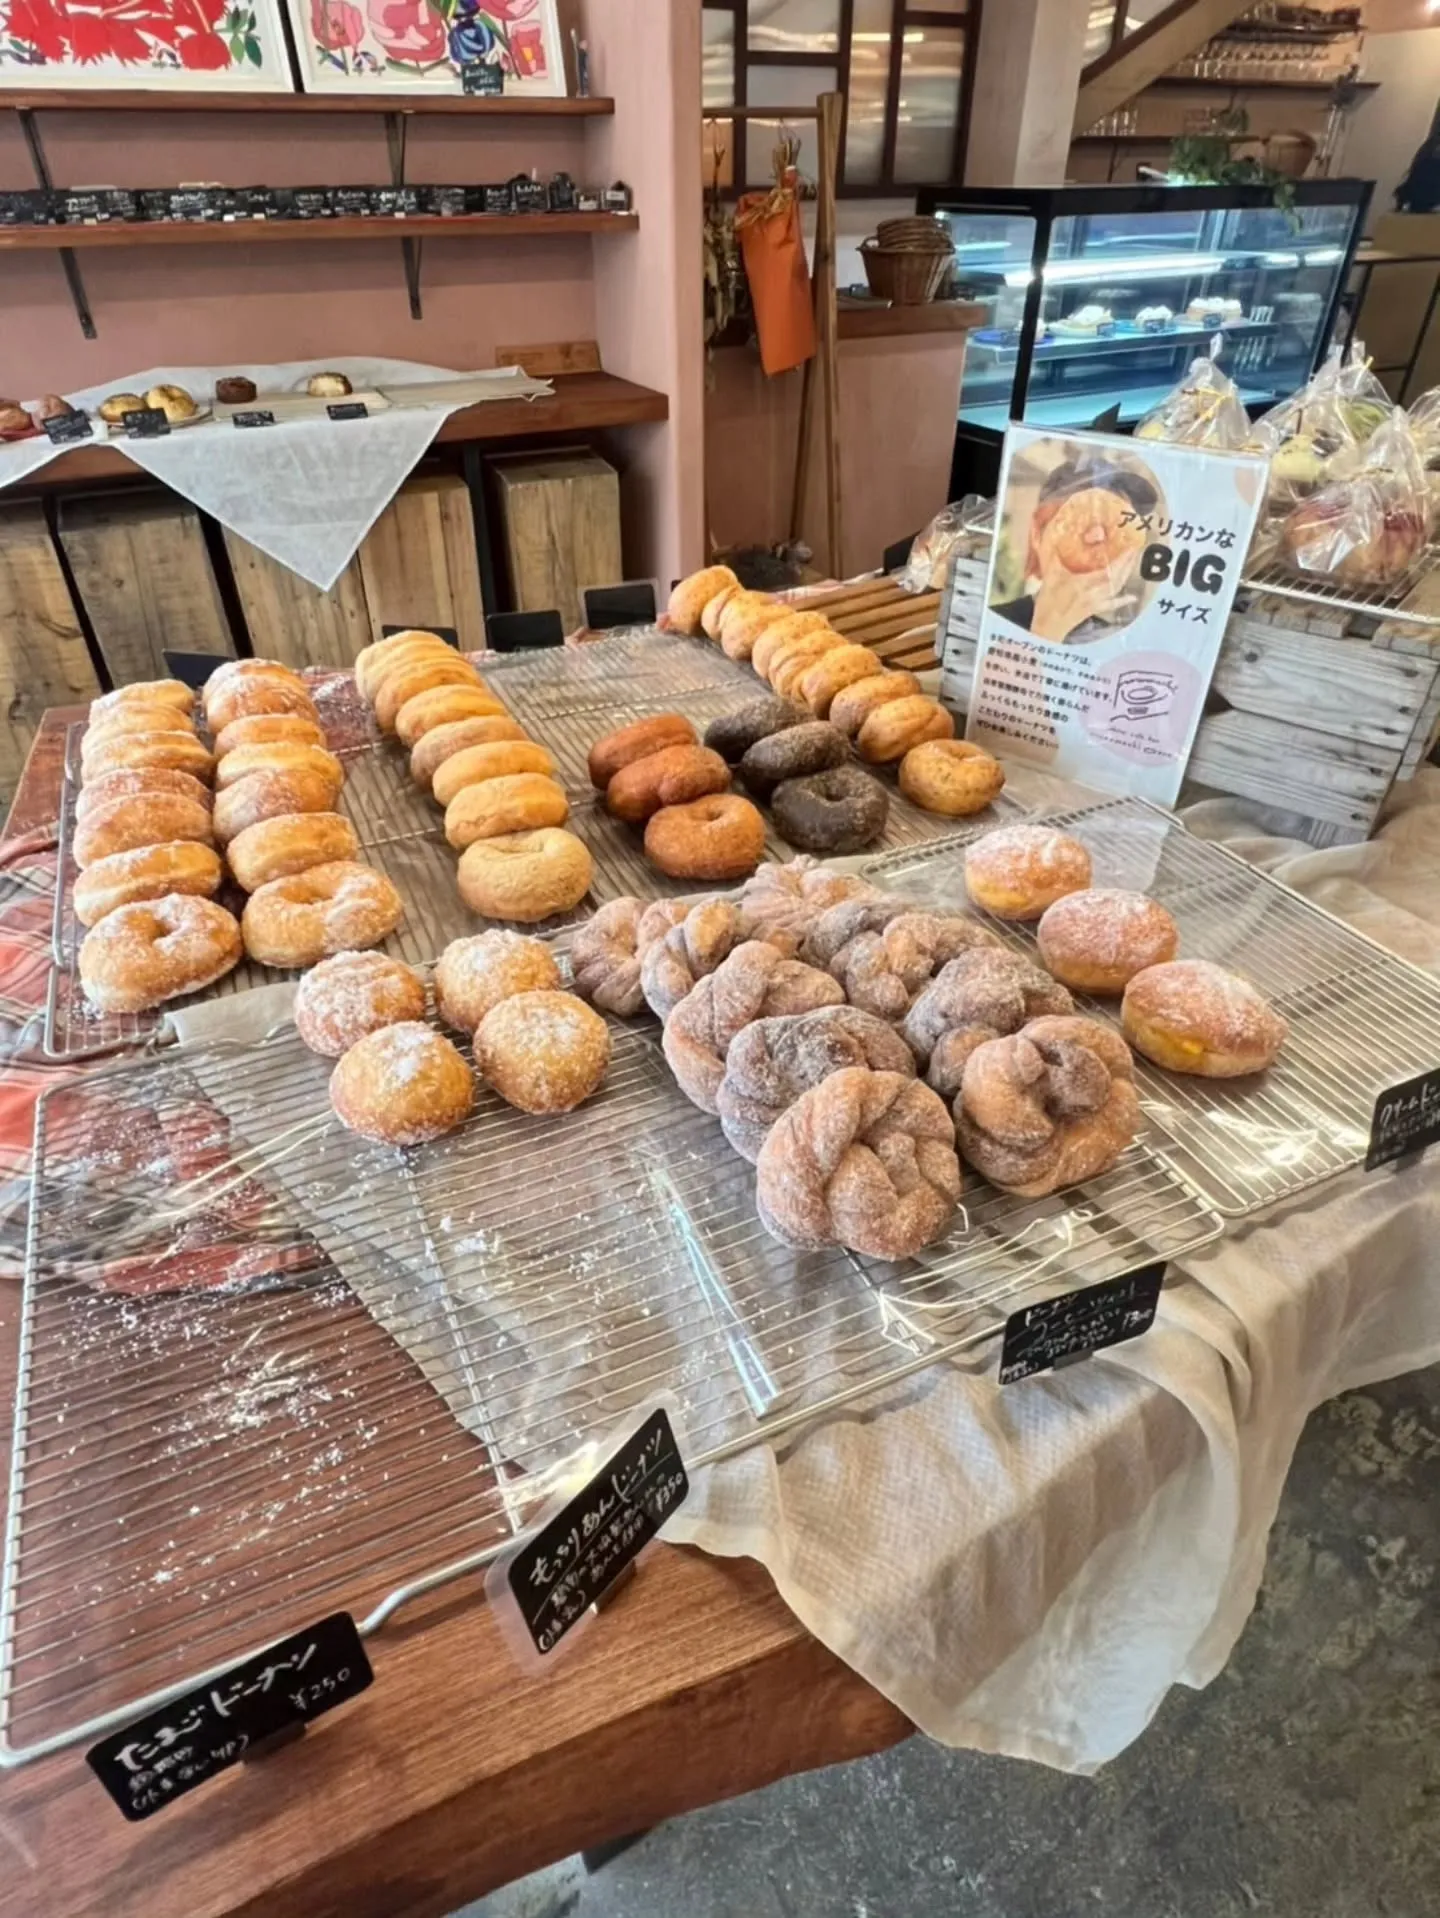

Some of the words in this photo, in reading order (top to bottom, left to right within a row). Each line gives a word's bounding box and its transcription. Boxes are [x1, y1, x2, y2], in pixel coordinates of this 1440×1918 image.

[1118, 511, 1236, 549] アメリカンな
[1141, 543, 1226, 595] BIG
[1158, 598, 1212, 624] サイズ
[289, 1667, 350, 1711] ¥250
